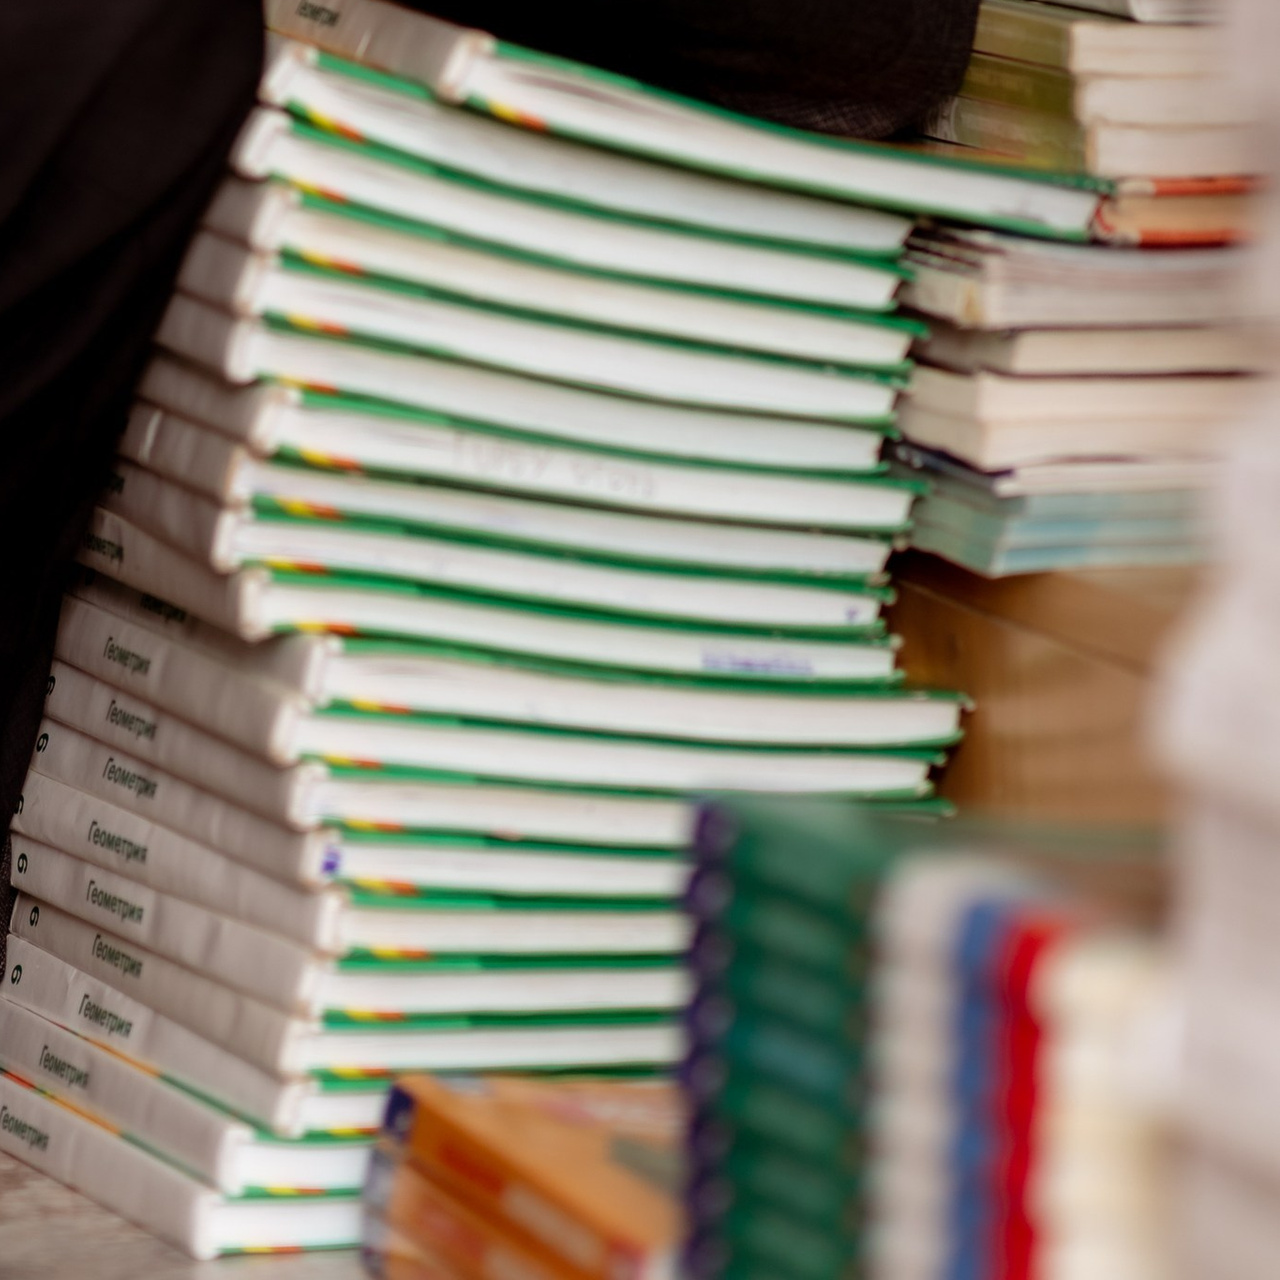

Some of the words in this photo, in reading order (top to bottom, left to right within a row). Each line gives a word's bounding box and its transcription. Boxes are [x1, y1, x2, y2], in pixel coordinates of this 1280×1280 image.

[103, 636, 152, 676] Геометрия
[106, 699, 158, 741] Геометрия
[102, 757, 158, 800] Геометрия
[88, 821, 148, 865] Геометрия
[86, 879, 144, 925] Геометрия
[91, 934, 143, 978] Геометрия
[78, 993, 134, 1039] Геометрия
[38, 1044, 89, 1089] Геометрия
